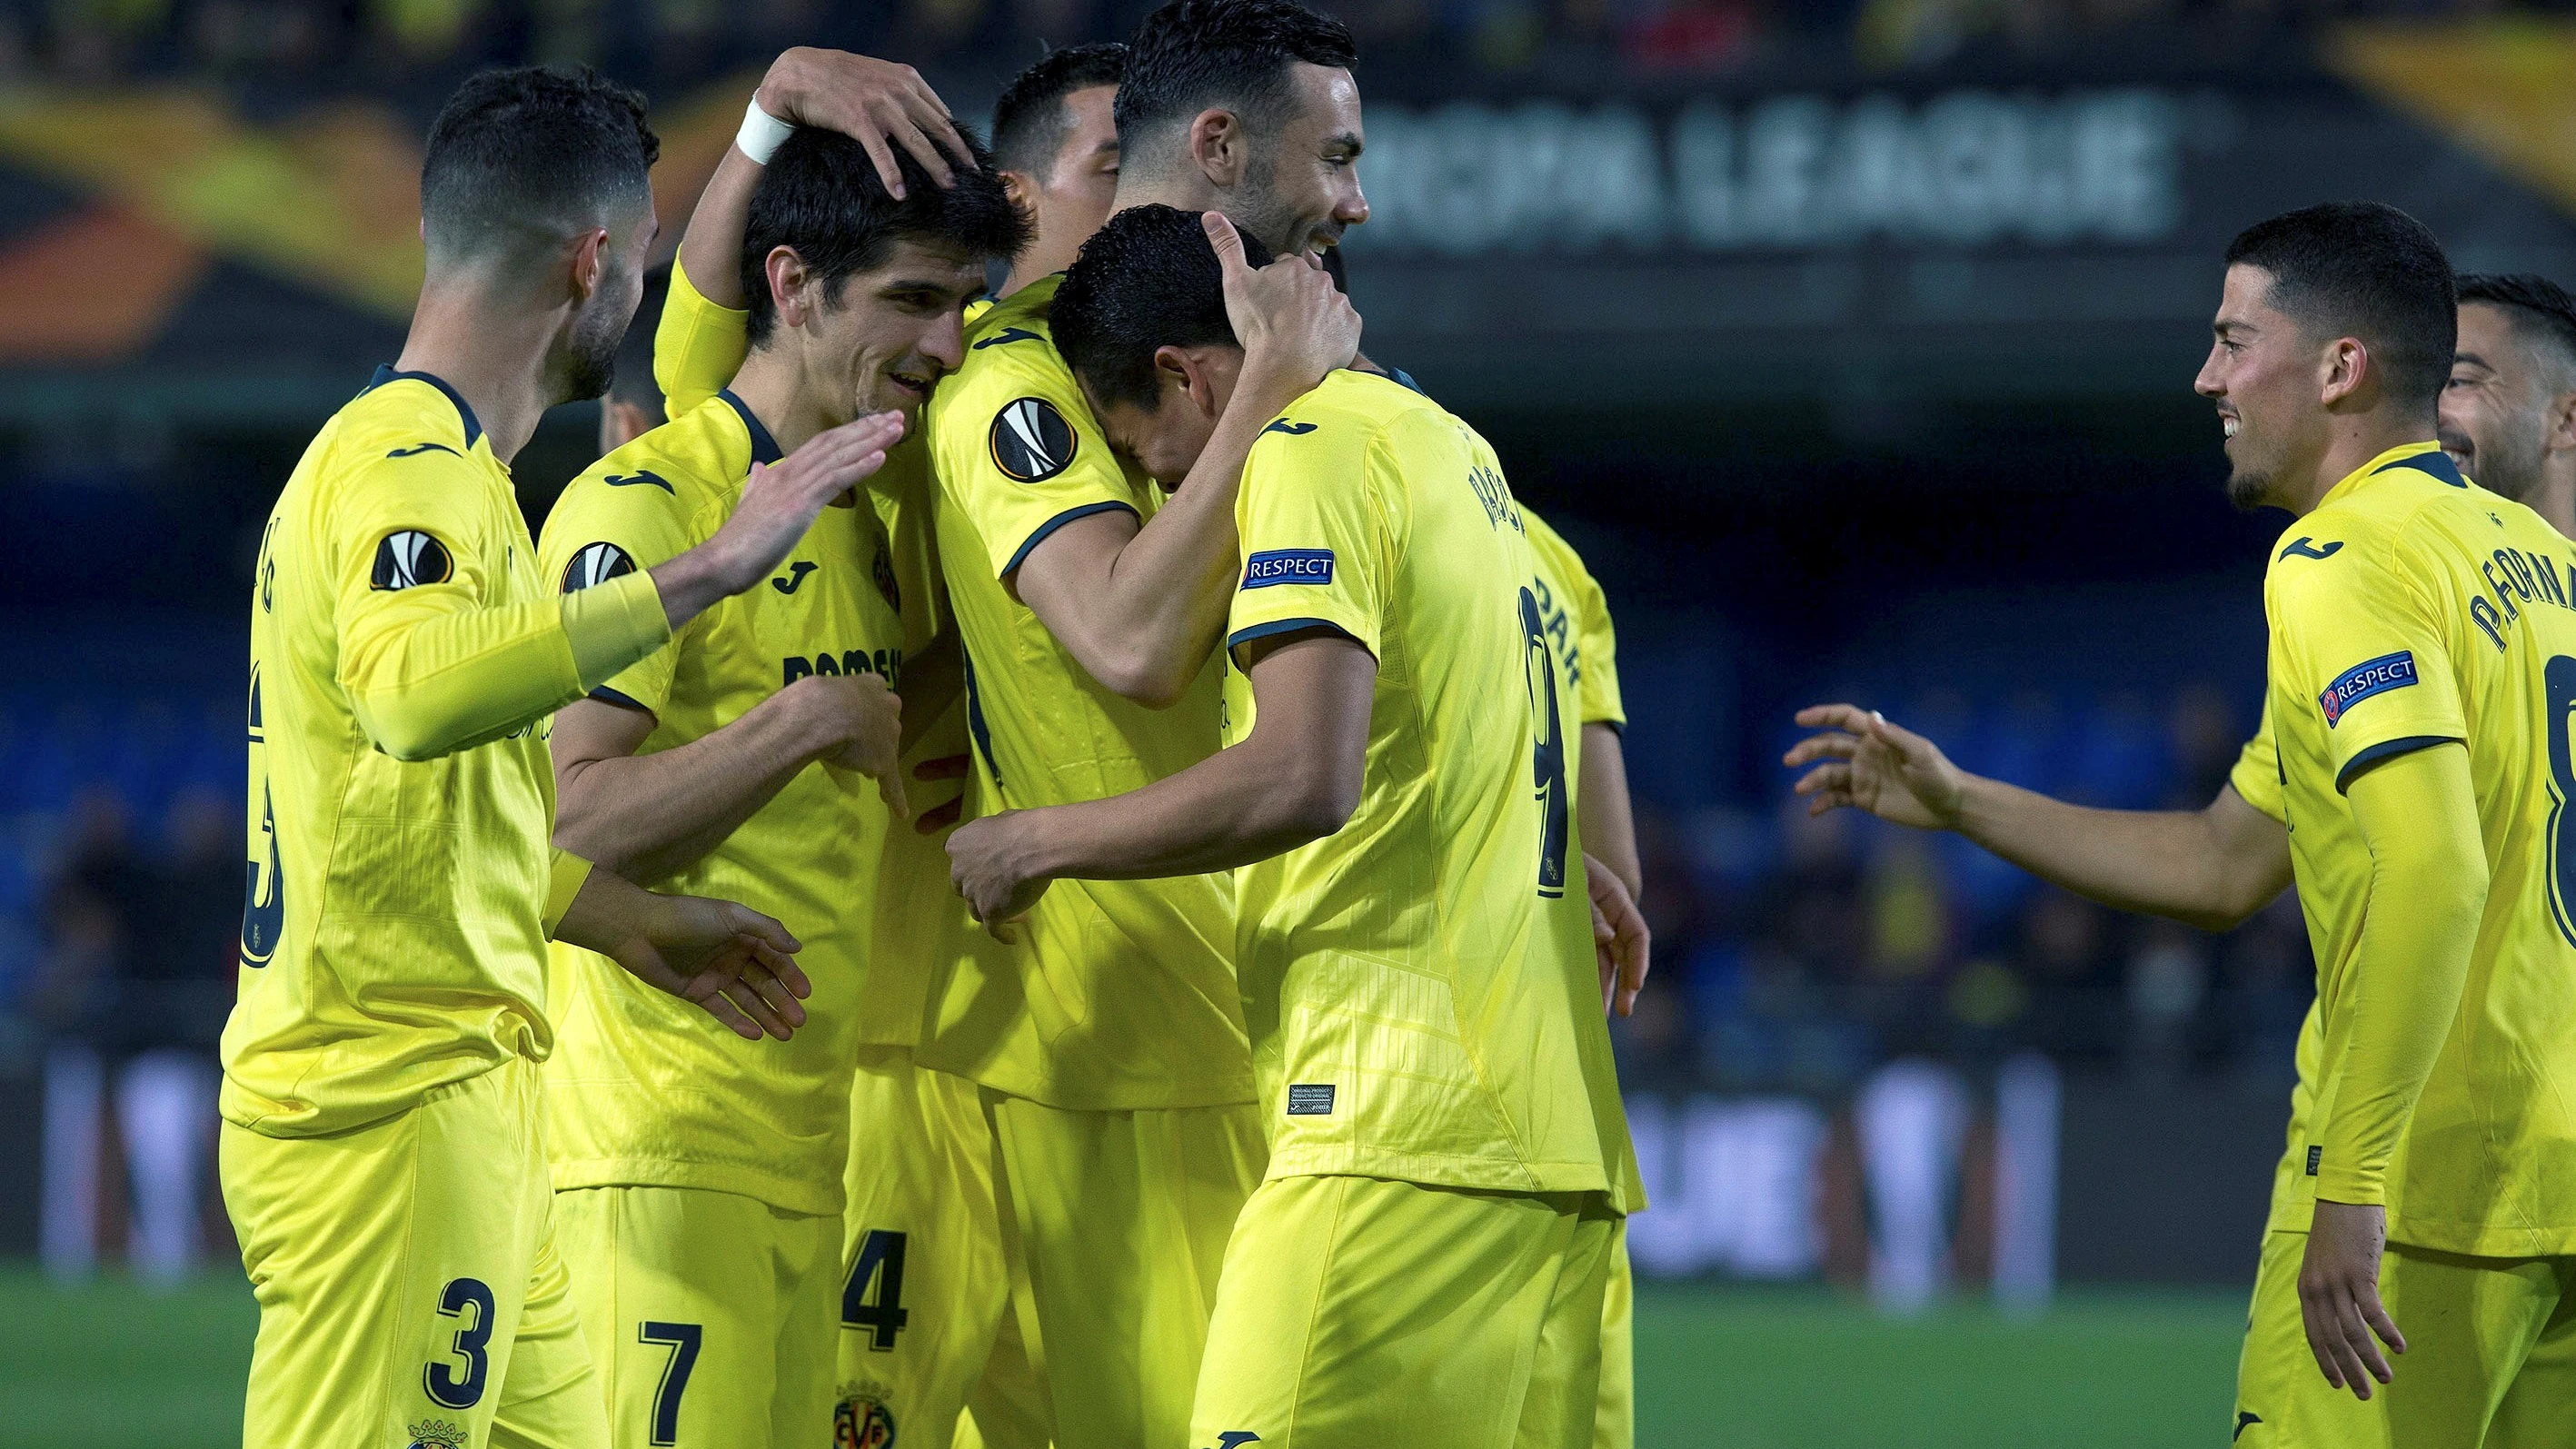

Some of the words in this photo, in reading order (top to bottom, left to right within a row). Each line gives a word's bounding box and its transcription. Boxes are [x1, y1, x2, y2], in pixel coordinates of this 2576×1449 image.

[1467, 465, 1526, 539] BACC
[1250, 559, 1332, 578] RESPECT
[2337, 660, 2412, 702] RESPECT
[840, 1229, 909, 1353] 4
[423, 1276, 495, 1410] 3
[638, 1321, 702, 1447] 7
